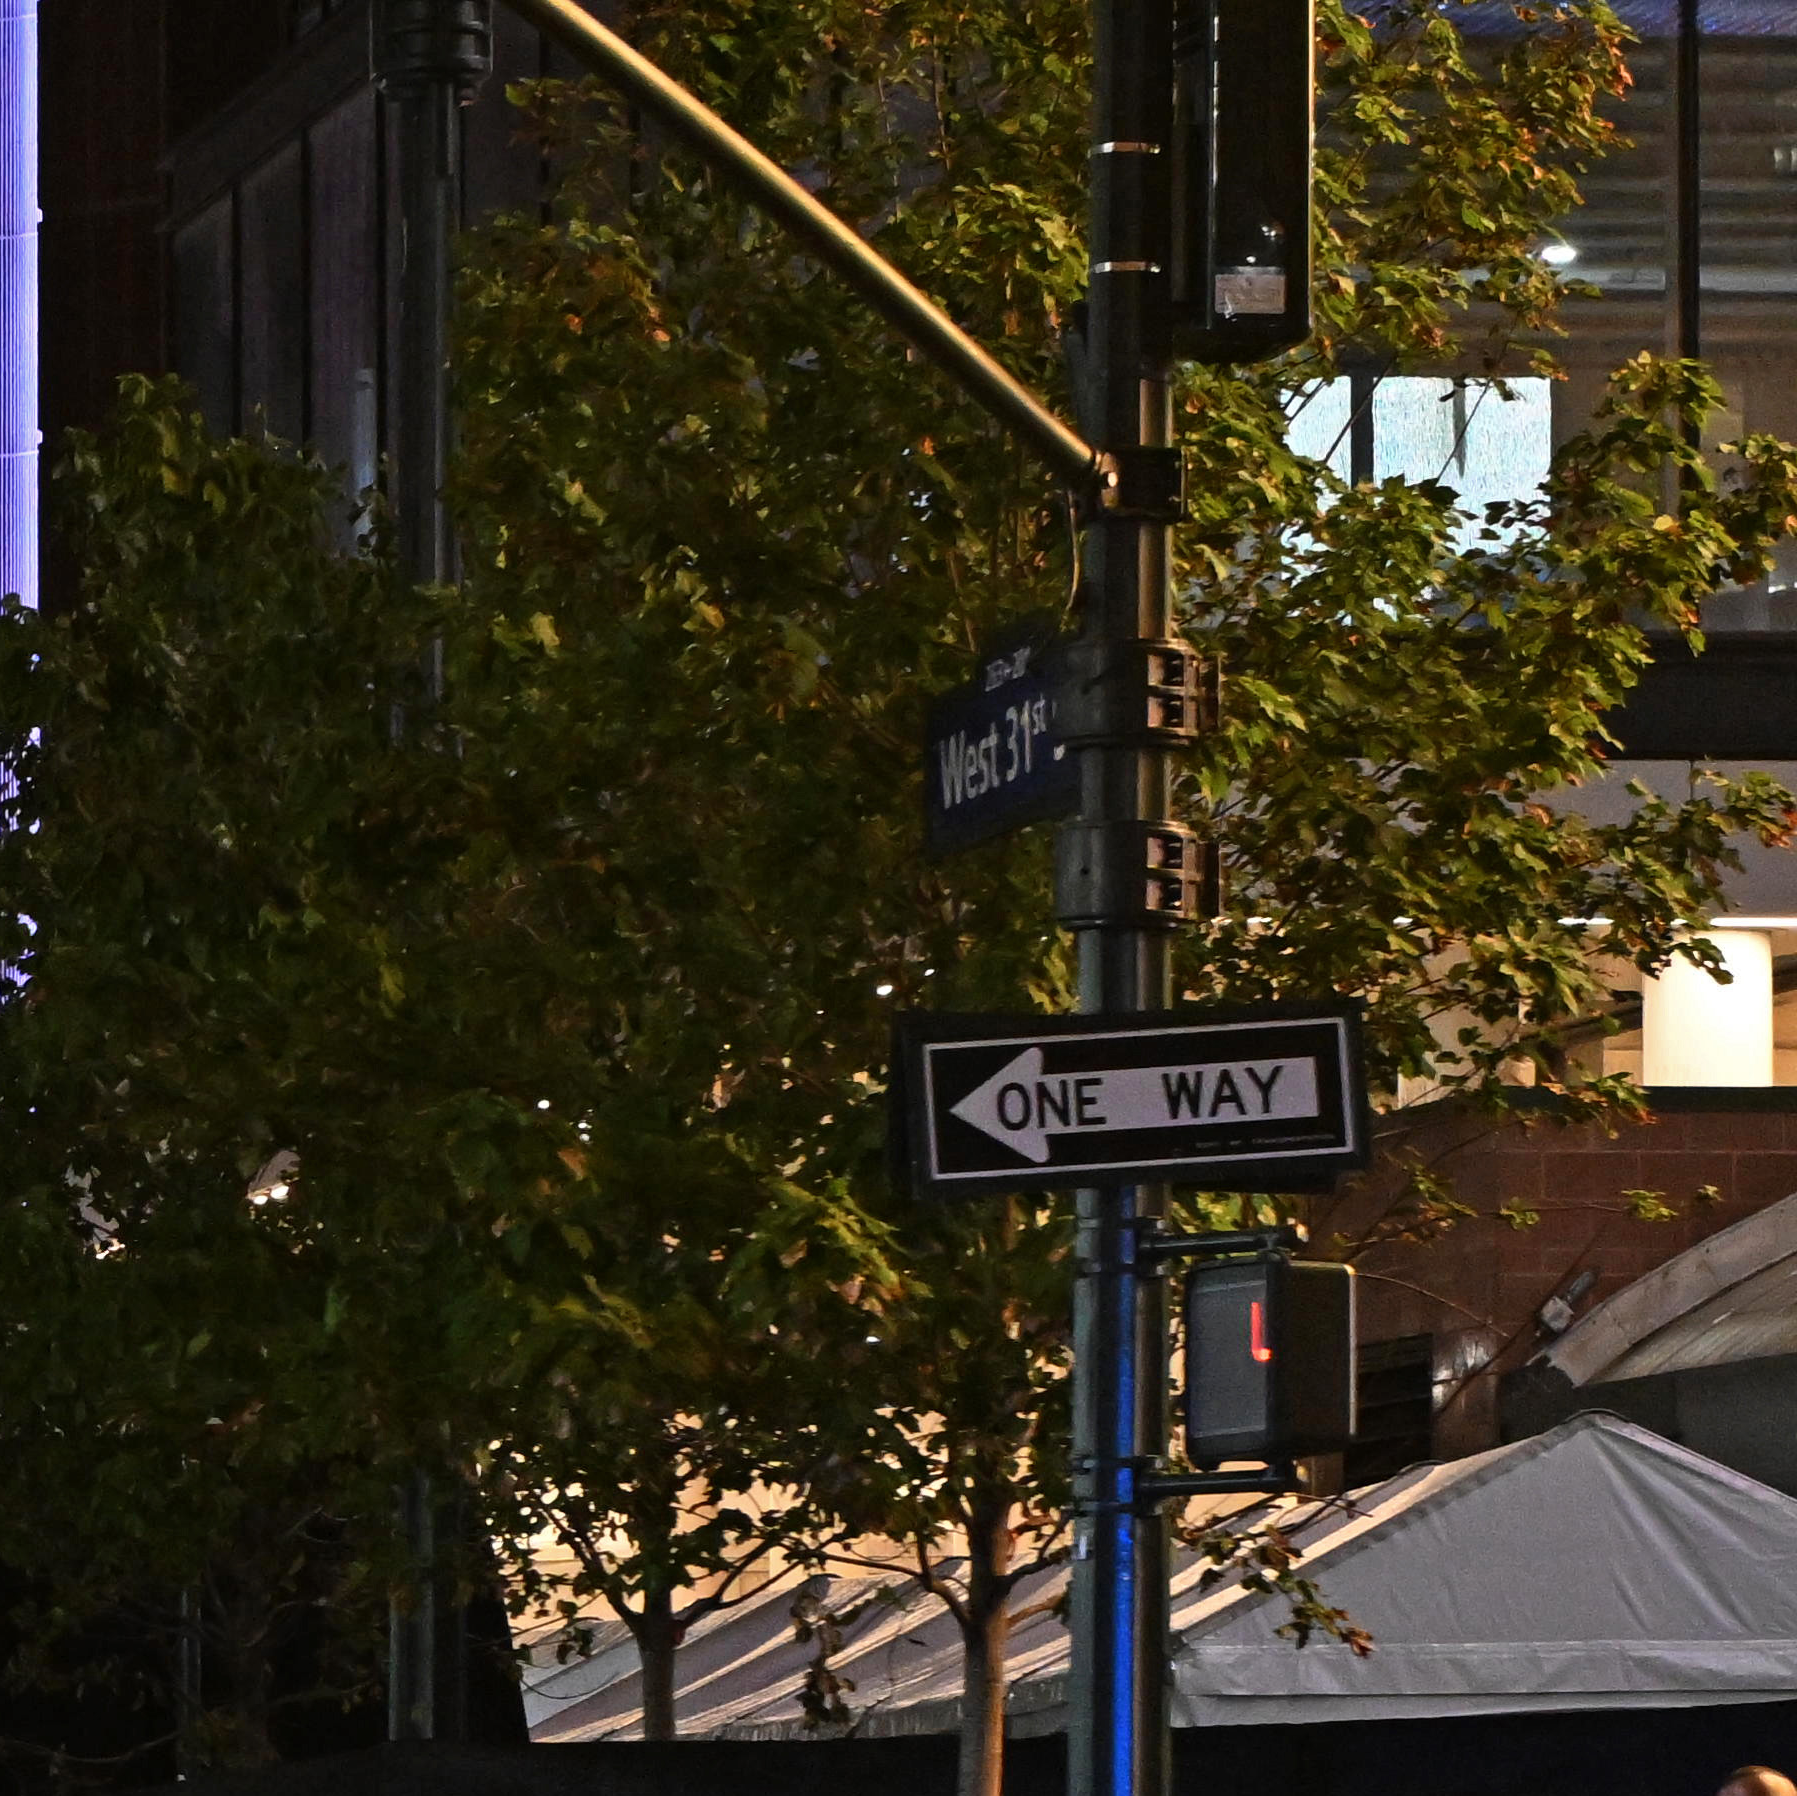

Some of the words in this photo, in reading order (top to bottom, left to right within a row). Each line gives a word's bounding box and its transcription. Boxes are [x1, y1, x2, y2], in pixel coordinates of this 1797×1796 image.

[938, 721, 1000, 811] West
[1005, 692, 1047, 783] 31st
[996, 1077, 1107, 1132] ONE
[1161, 1065, 1284, 1120] WAY
